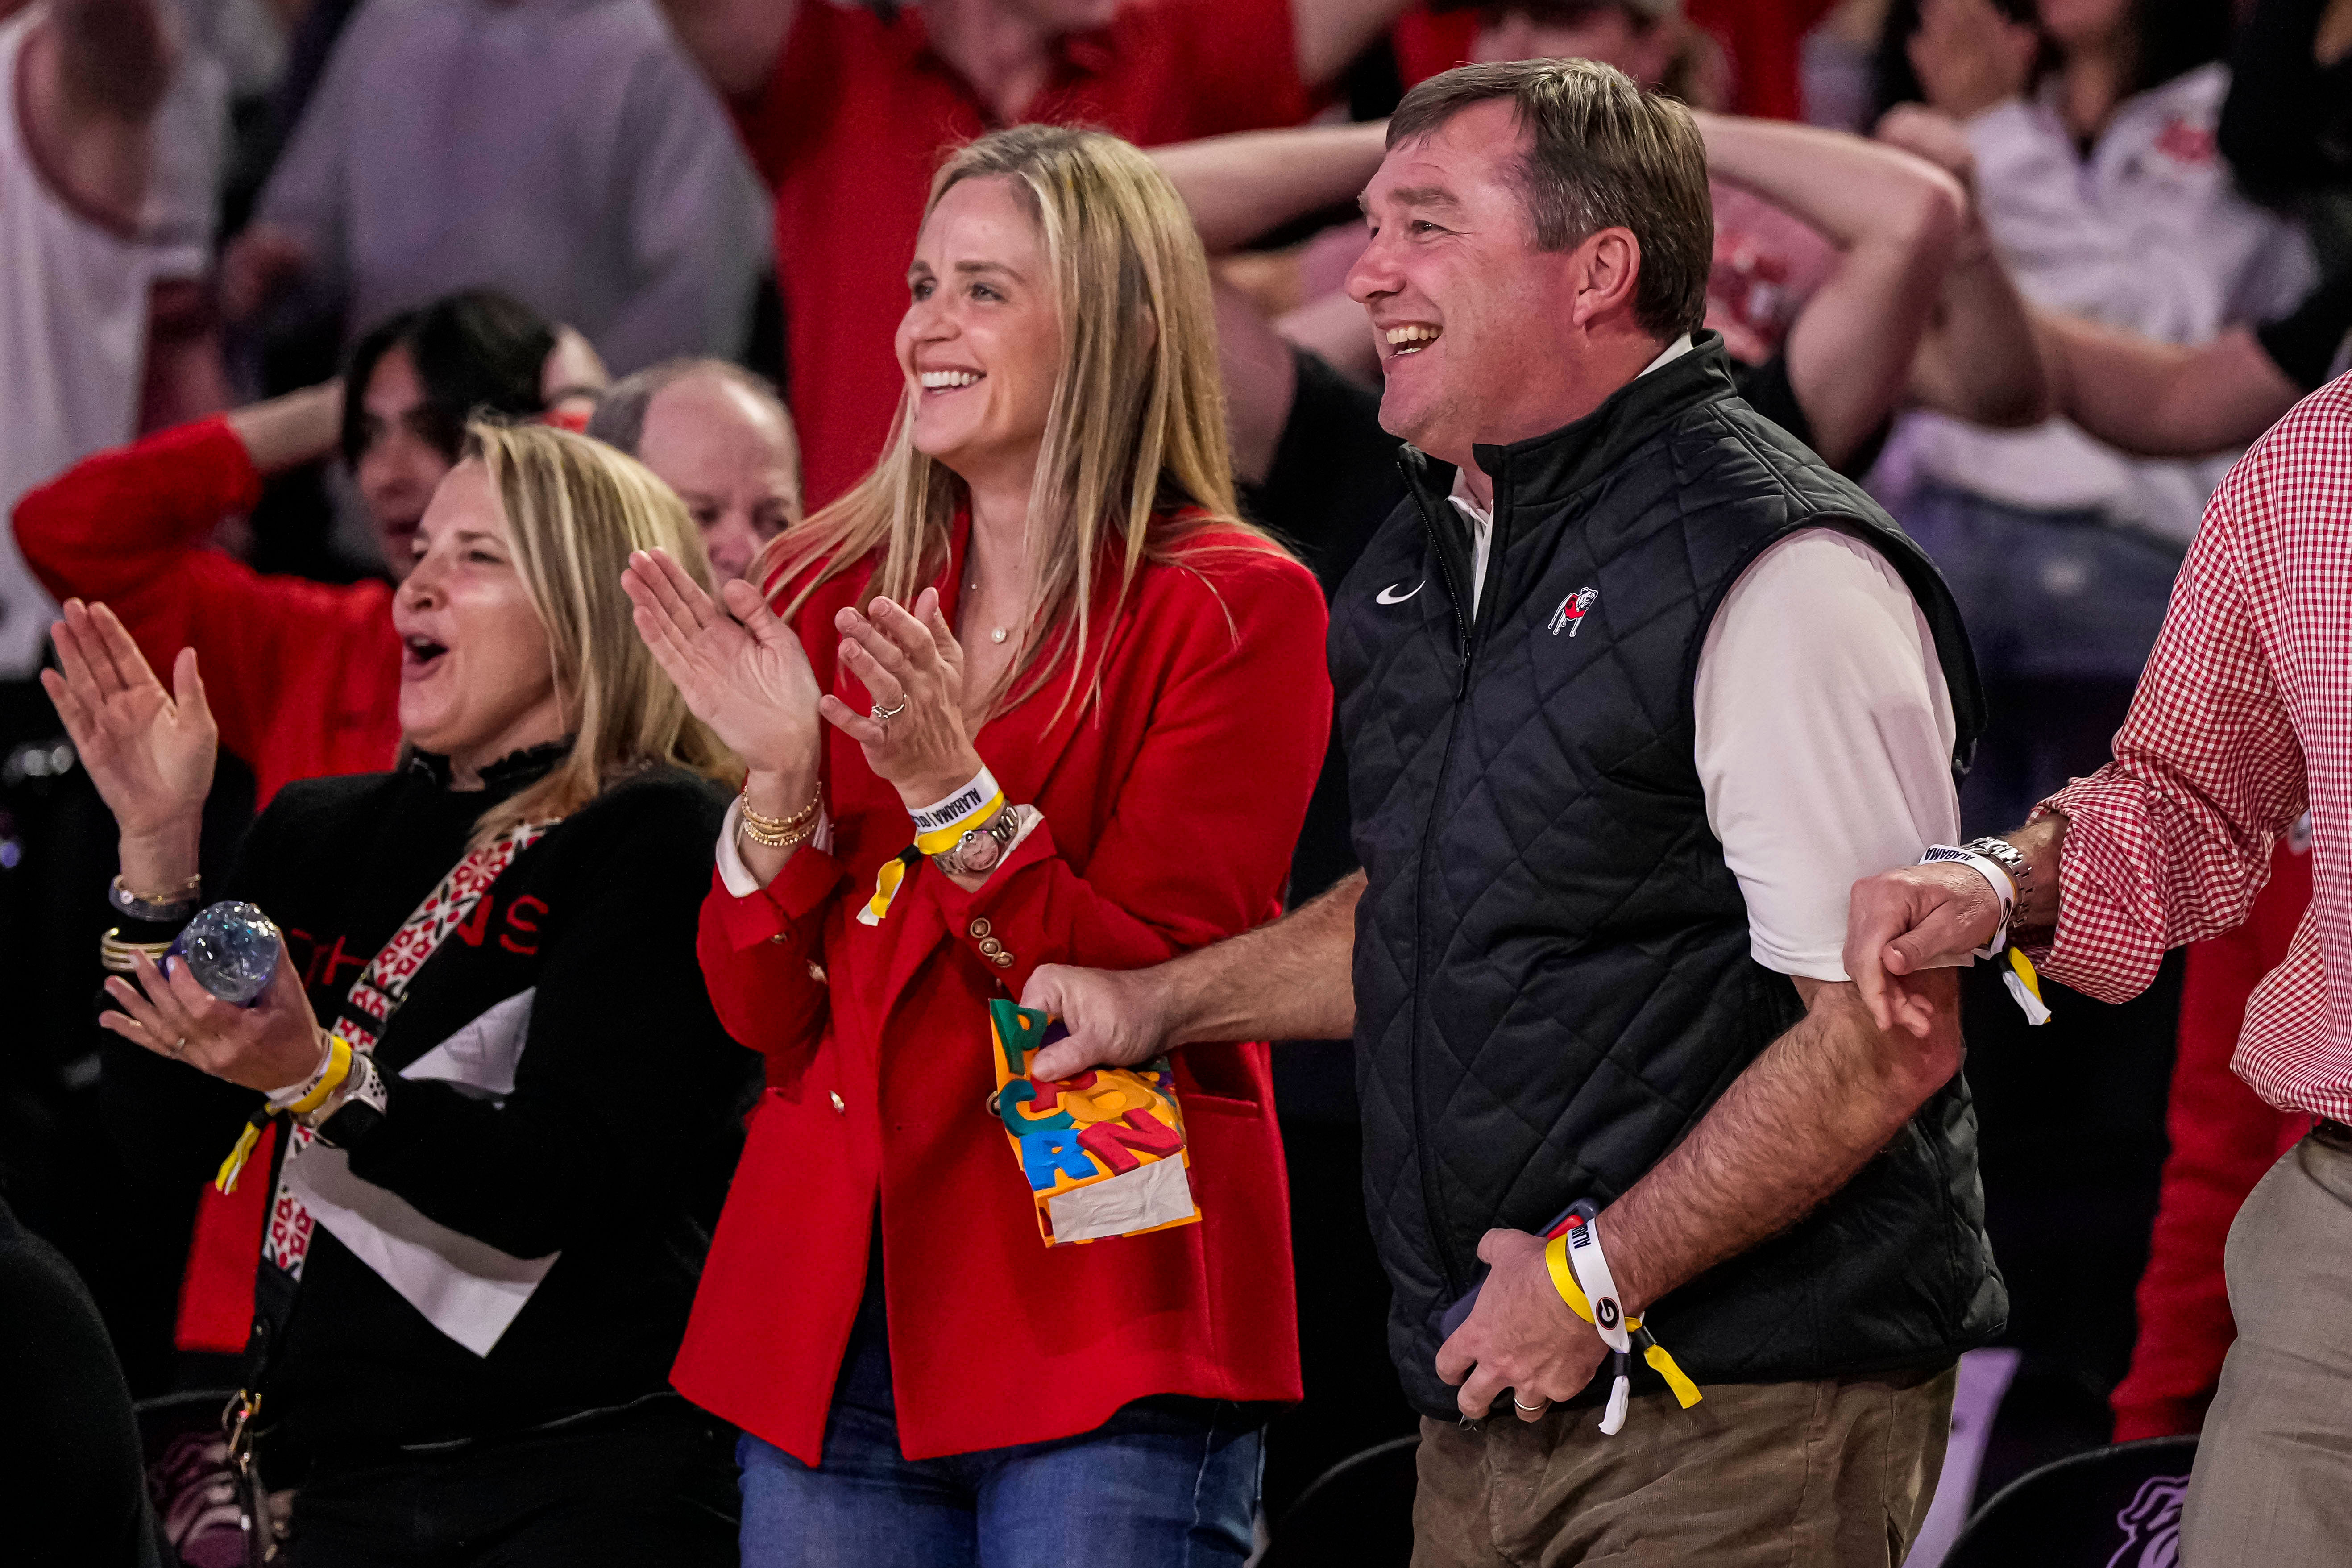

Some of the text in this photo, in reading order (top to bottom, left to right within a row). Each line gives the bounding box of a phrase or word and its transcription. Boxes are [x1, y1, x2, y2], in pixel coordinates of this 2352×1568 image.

[932, 788, 982, 824] ALABAMA
[1924, 848, 1976, 861] ALABAMA
[1572, 1224, 1591, 1249] ALAB
